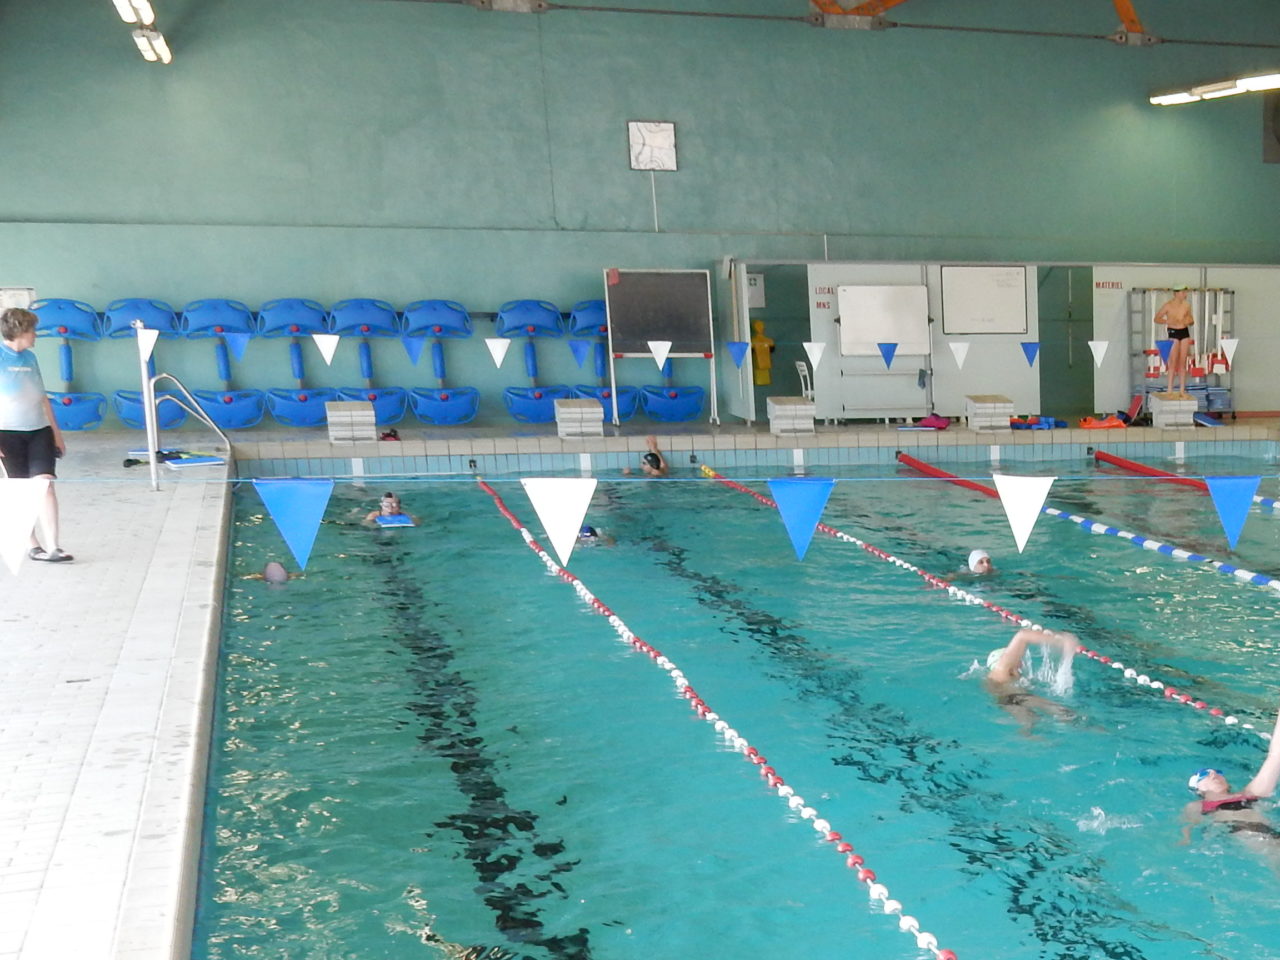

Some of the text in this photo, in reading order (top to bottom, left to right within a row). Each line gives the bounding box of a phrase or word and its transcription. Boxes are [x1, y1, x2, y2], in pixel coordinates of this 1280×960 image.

[1095, 281, 1123, 289] MATERIEL
[815, 286, 834, 295] LOCAL
[816, 301, 831, 309] MNS
